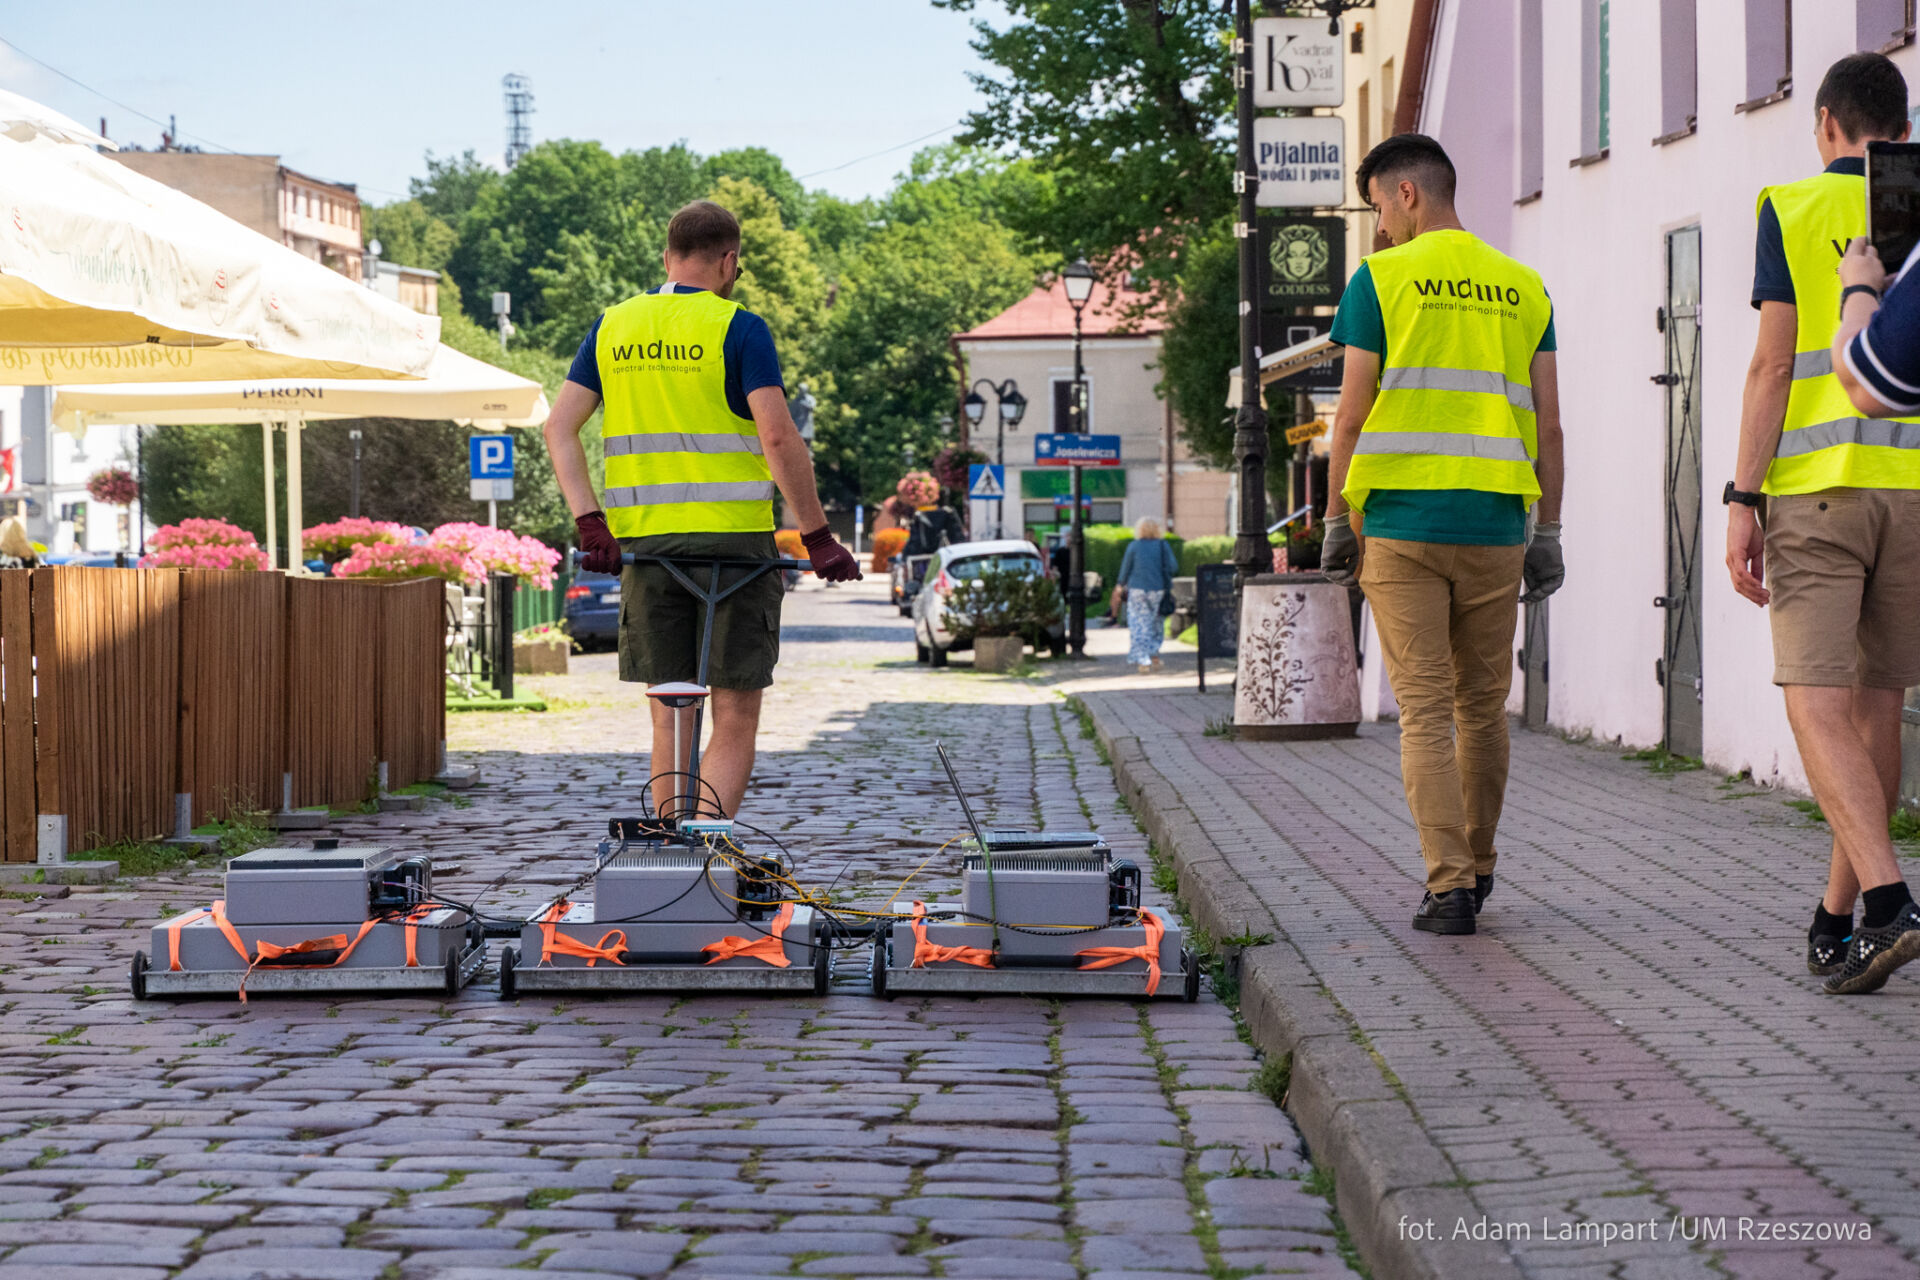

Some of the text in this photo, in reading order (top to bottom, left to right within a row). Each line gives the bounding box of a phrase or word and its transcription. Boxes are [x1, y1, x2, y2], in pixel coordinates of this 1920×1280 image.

[1260, 141, 1339, 166] Pijalnia
[1259, 166, 1340, 182] wódki i piwa
[1269, 284, 1331, 295] GODDESS
[613, 363, 702, 374] spectral technologies
[243, 386, 324, 398] PERONI
[480, 440, 505, 474] P
